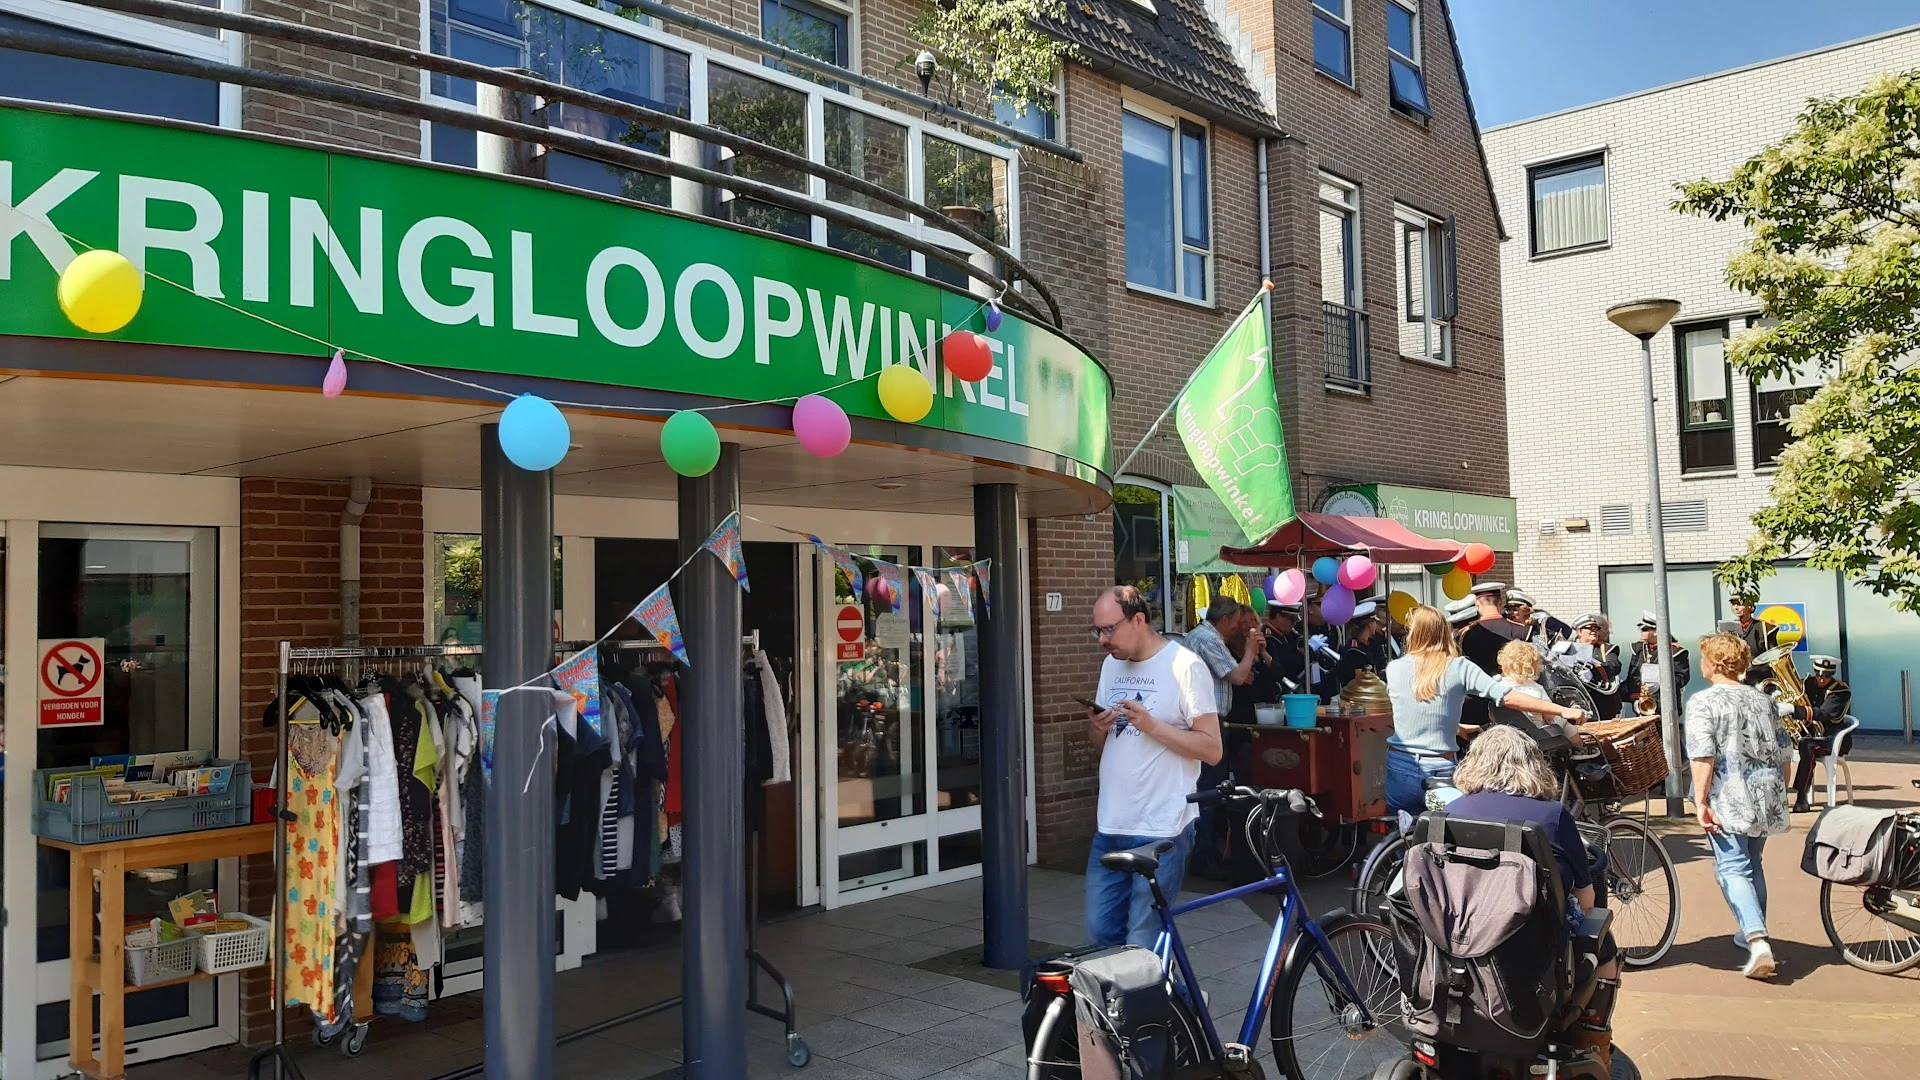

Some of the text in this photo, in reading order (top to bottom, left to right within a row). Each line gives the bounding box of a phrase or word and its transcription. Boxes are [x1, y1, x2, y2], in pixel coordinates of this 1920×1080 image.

[1180, 400, 1263, 525] Kringloopwinkel
[1414, 508, 1511, 533] KRINGLOOPWINKEL
[1048, 595, 1060, 609] 77
[1114, 676, 1155, 686] CALIFORNIA
[43, 701, 99, 710] VERBODEN VOOR
[56, 712, 85, 720] HONDEN
